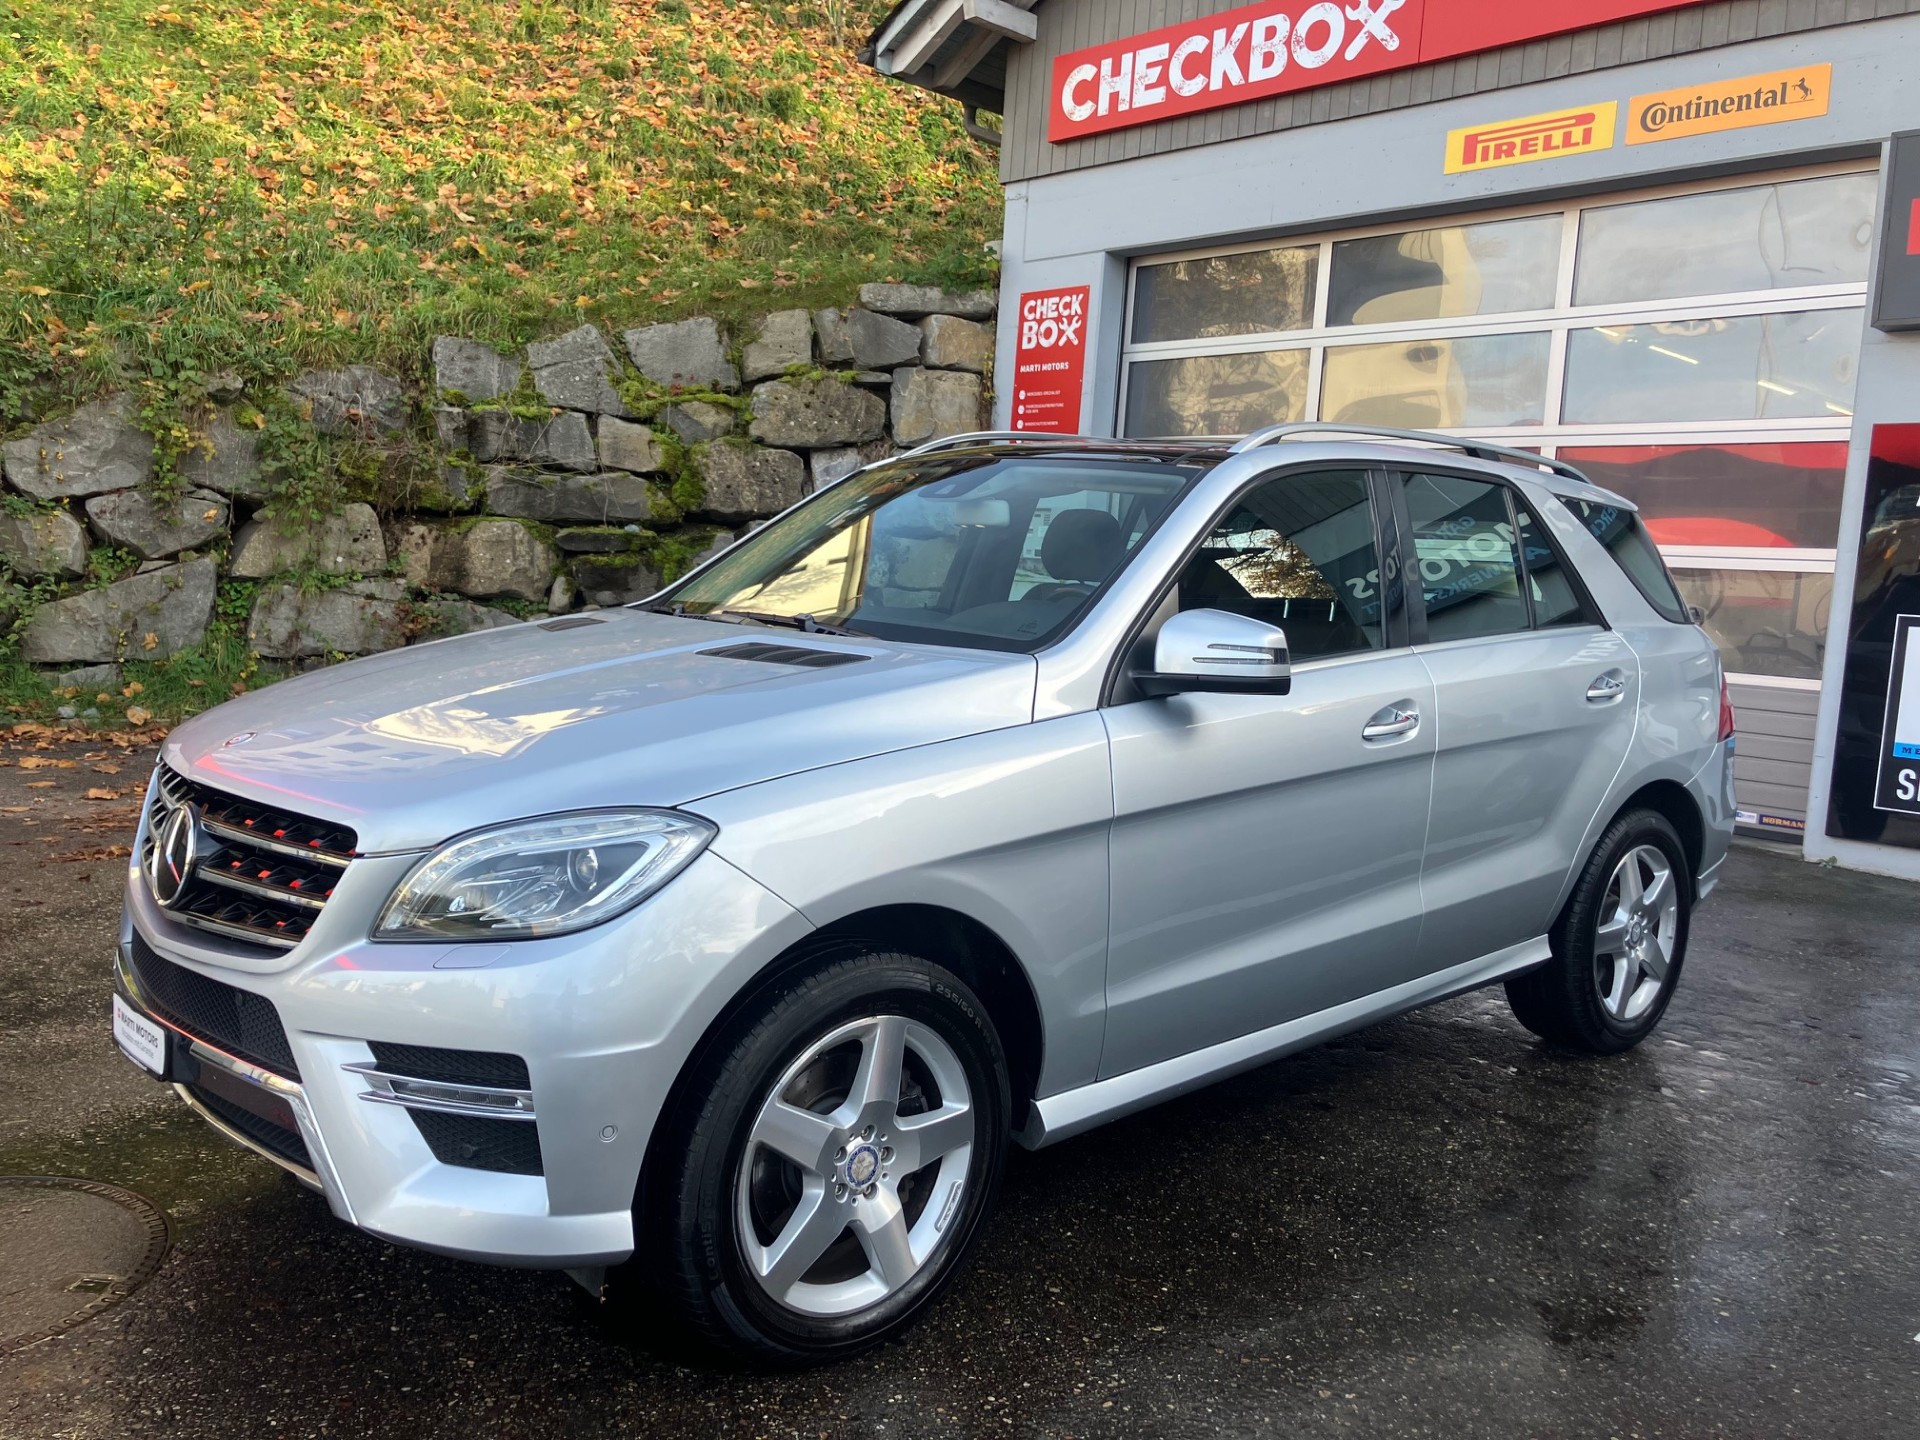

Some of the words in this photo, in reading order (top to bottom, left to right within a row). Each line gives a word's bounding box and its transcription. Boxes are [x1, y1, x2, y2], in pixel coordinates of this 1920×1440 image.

[1061, 0, 1401, 122] CHECKBOX
[1640, 82, 1788, 132] Continental
[1462, 112, 1596, 166] PIRELLI
[1023, 294, 1084, 321] CHECK
[1021, 316, 1082, 350] BOX
[1020, 363, 1041, 373] MARTI
[1041, 361, 1069, 372] MOTORS
[135, 1023, 159, 1048] MOTORS
